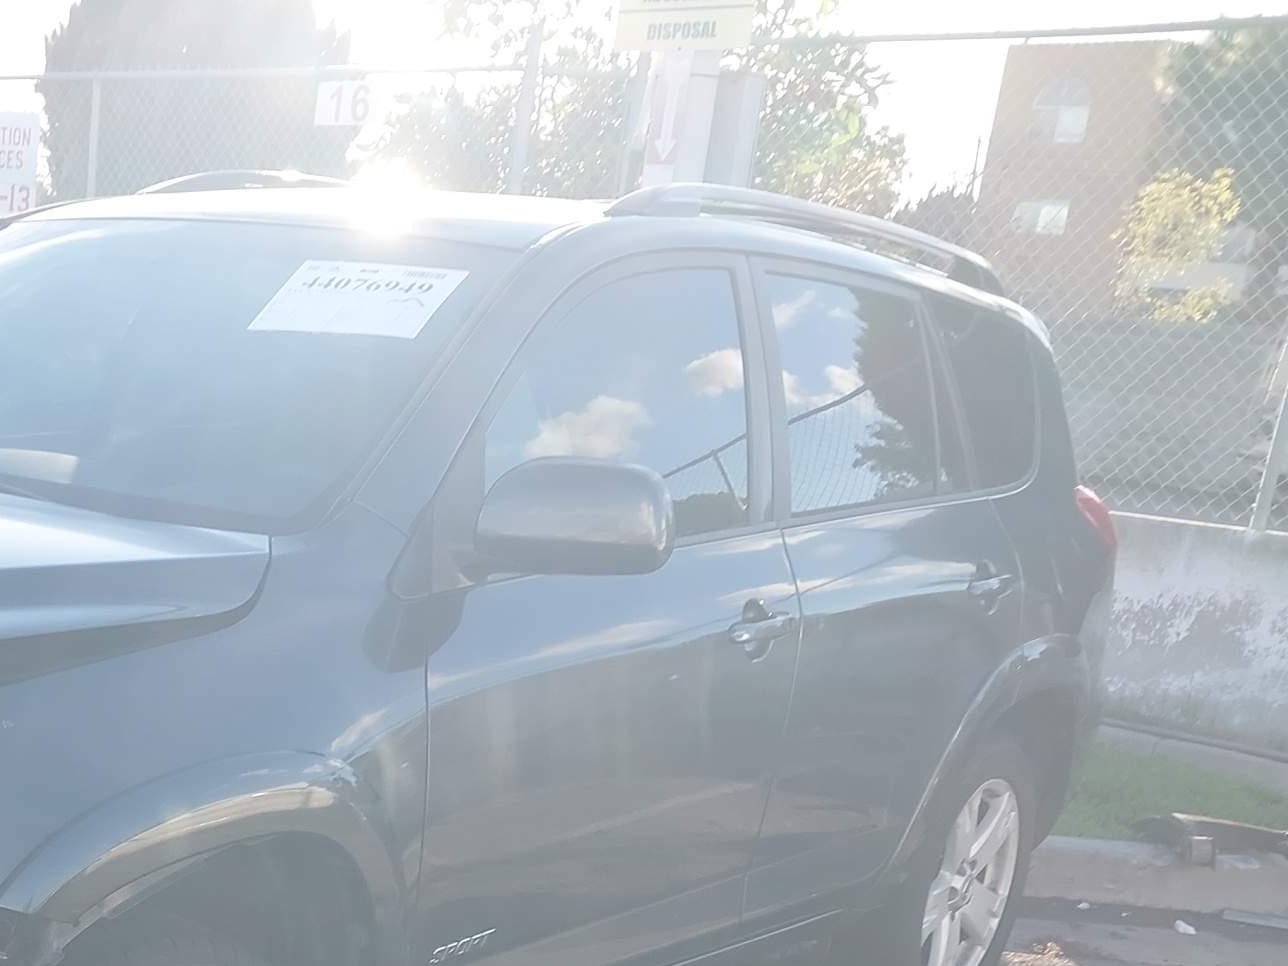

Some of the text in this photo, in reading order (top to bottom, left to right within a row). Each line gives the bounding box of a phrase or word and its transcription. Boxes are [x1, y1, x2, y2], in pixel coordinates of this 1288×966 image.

[647, 20, 717, 40] DISPOSAL
[330, 84, 370, 123] 16
[301, 275, 435, 295] 44076949
[429, 928, 497, 964] SPORT
